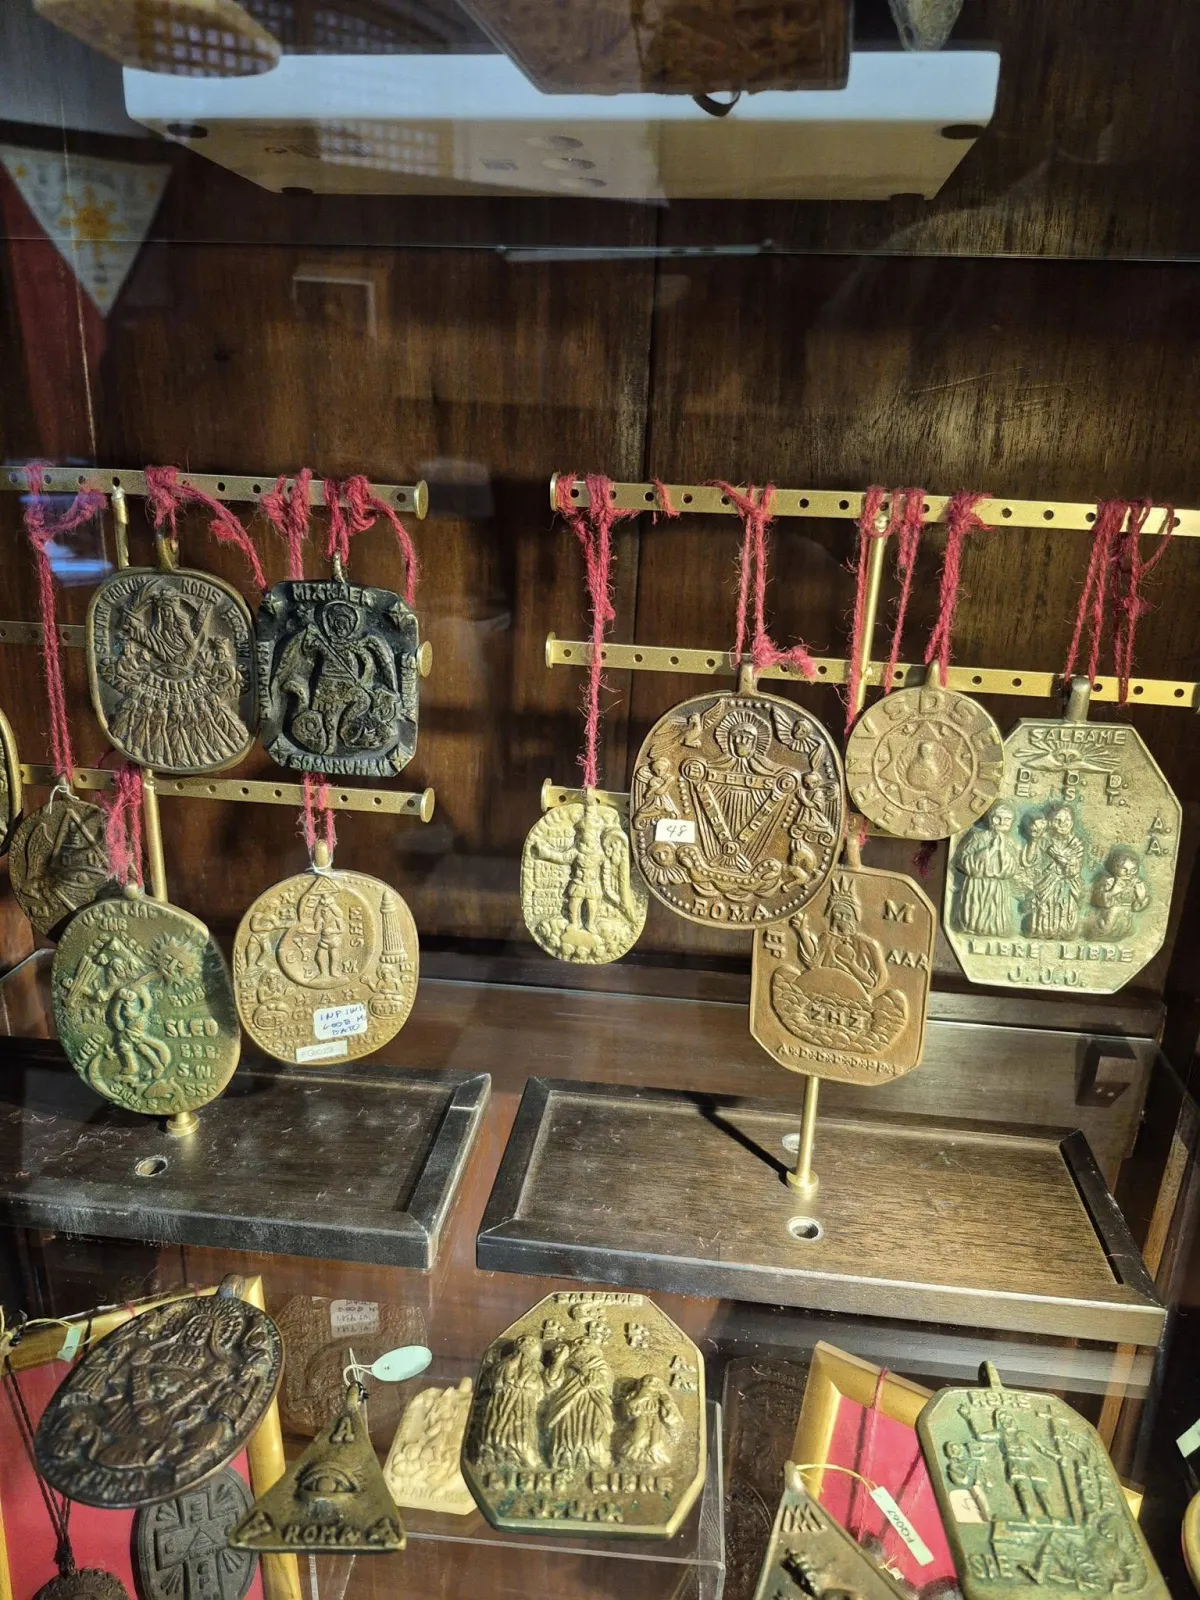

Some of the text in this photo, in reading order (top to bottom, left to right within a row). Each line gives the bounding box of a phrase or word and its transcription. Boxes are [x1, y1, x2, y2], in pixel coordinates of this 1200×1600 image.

[1029, 728, 1126, 746] SALBAME
[692, 898, 773, 923] ROMA
[882, 899, 915, 924] M
[968, 938, 1133, 963] LIBRE LIBRE
